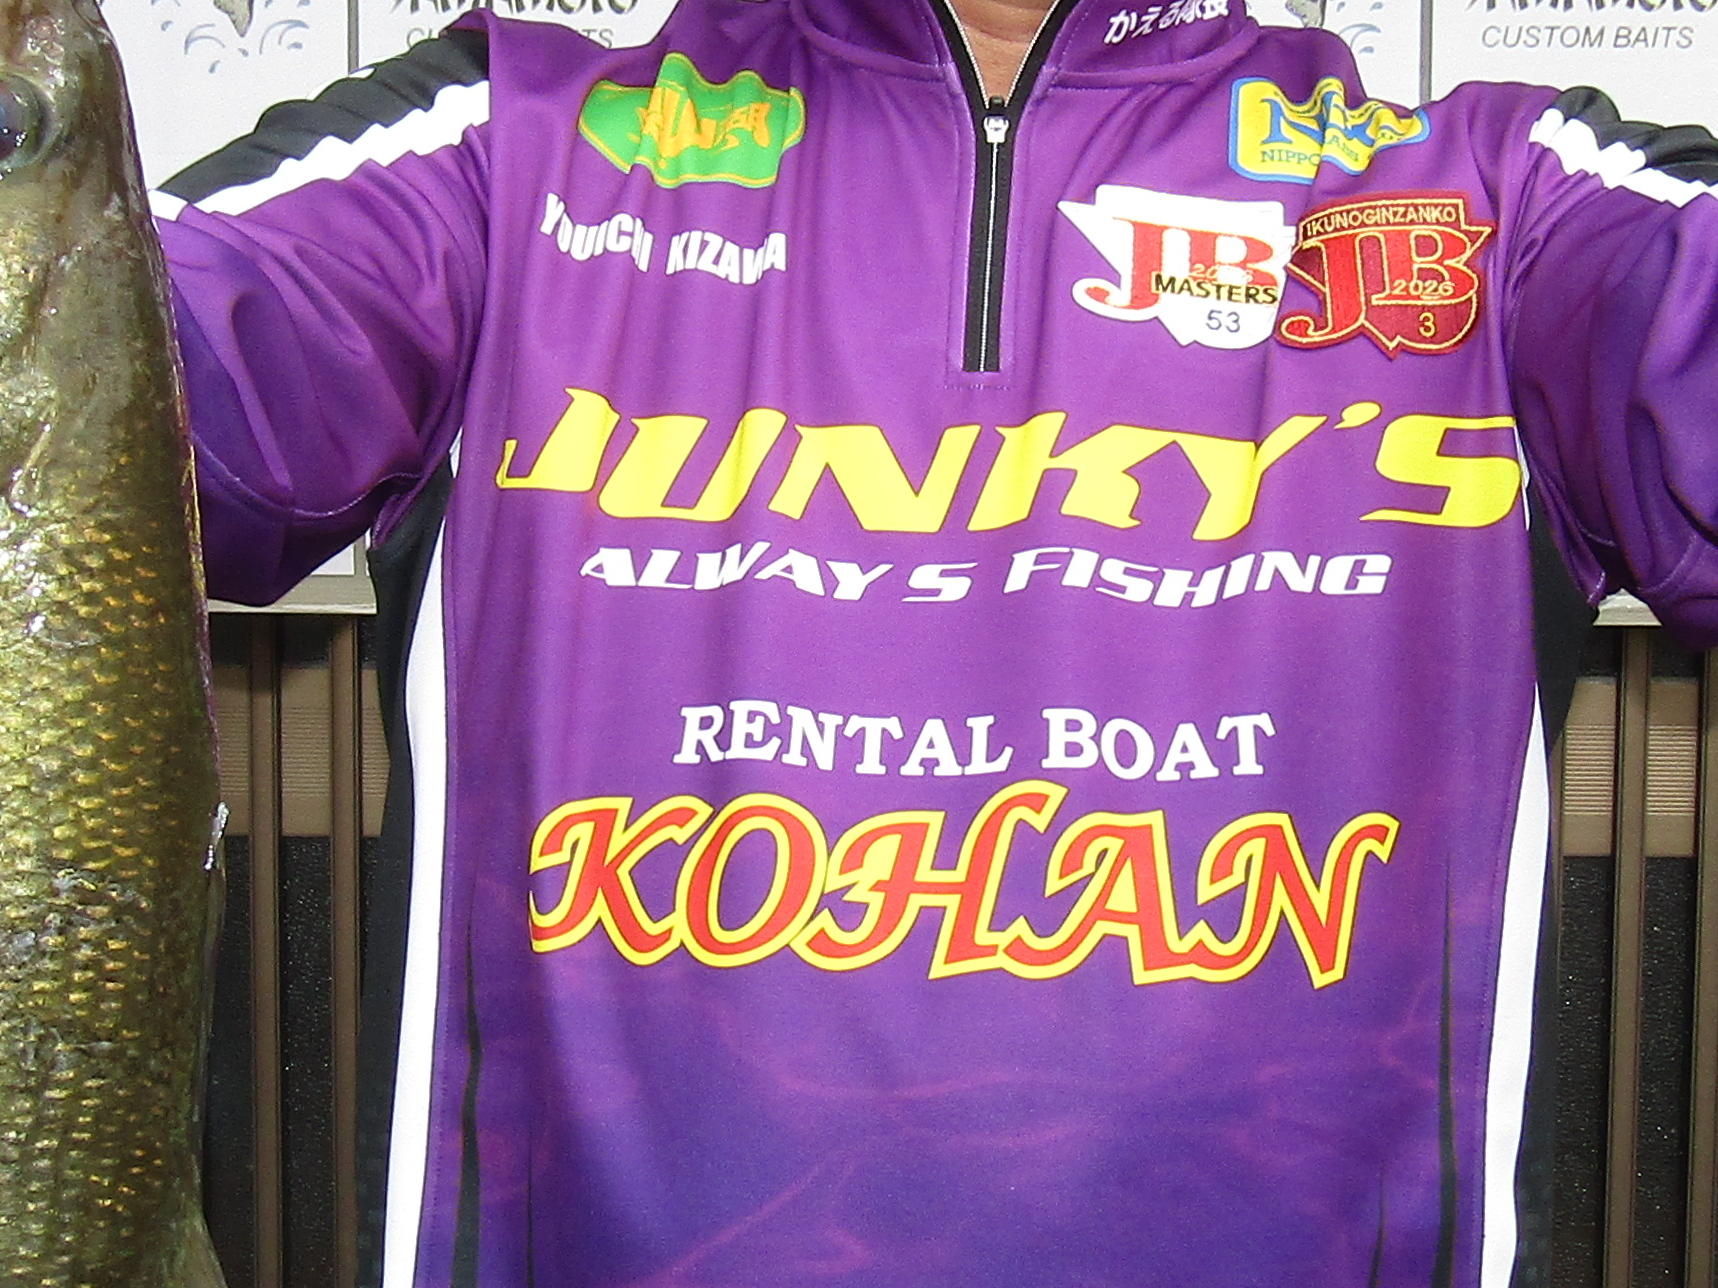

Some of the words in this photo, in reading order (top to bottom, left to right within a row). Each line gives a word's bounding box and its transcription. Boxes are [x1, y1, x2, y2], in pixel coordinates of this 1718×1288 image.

[1482, 25, 1607, 51] CUSTOM
[1613, 25, 1695, 51] BAITS
[1259, 148, 1322, 168] NIPPO
[1304, 205, 1457, 238] IKUNOGINZANKO
[1084, 215, 1277, 311] JB
[1153, 272, 1278, 306] MASTERS
[1281, 226, 1479, 344] JB
[1391, 277, 1456, 299] 2026
[1205, 309, 1241, 334] 53
[1418, 311, 1437, 338] 3
[580, 541, 978, 604] ALWAYS
[1003, 547, 1393, 608] FISHING
[672, 699, 1013, 776] RENTAL
[1040, 708, 1275, 781] BOAT
[527, 780, 1400, 988] KOHAN
